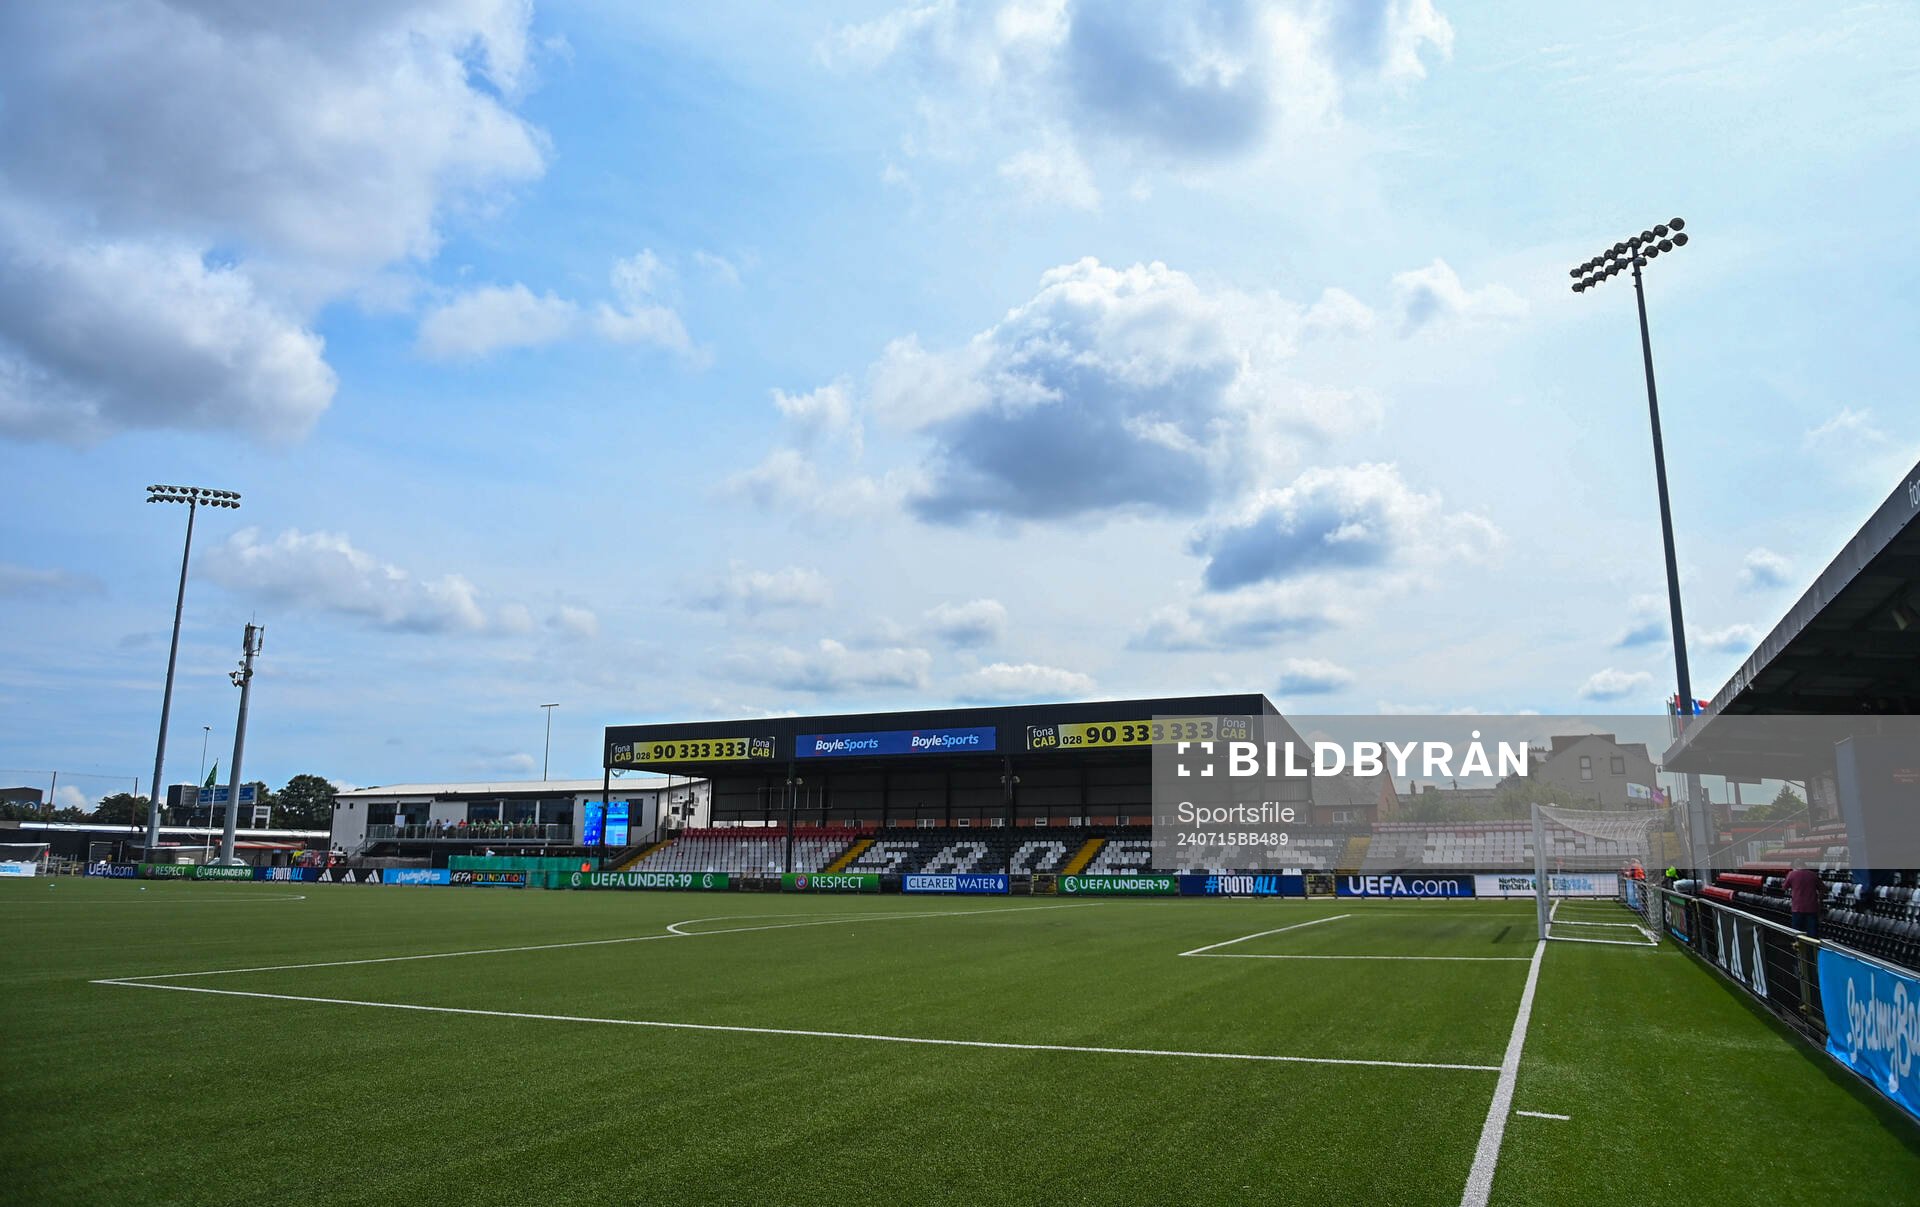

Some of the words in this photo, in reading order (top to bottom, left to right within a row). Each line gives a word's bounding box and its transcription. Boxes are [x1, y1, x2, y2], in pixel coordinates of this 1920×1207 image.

[1222, 717, 1246, 728] fona
[1032, 725, 1054, 737] fona
[1062, 735, 1082, 745] 028
[1086, 726, 1117, 744] 90
[1122, 724, 1165, 742] 333
[1170, 721, 1214, 740] 333
[1221, 728, 1247, 739] CAB
[753, 738, 770, 748] fona
[815, 738, 879, 752] BoyleSports
[911, 734, 979, 749] BoyleSports
[1032, 736, 1056, 748] CAB
[614, 744, 631, 753] fona
[636, 751, 651, 760] 028
[653, 744, 676, 759] 90
[679, 743, 711, 758] 333
[714, 741, 747, 757] 333
[751, 747, 770, 757] CAB
[614, 751, 632, 762] CAB
[155, 866, 187, 876] RESPECT
[265, 867, 304, 880] #FOOTBALL
[450, 872, 472, 881] UEFA
[472, 873, 525, 882] FOUNDATION
[591, 873, 626, 887] UEFA
[628, 873, 692, 887] UNDER-19
[812, 876, 864, 889] RESPECT
[908, 877, 955, 889] CLEARER
[958, 877, 996, 889] WATER
[1079, 878, 1112, 890] UEFA
[1113, 878, 1170, 890] UNDER-19
[1204, 876, 1278, 894] #FOOTBALL
[1349, 876, 1459, 895] UEFA.com
